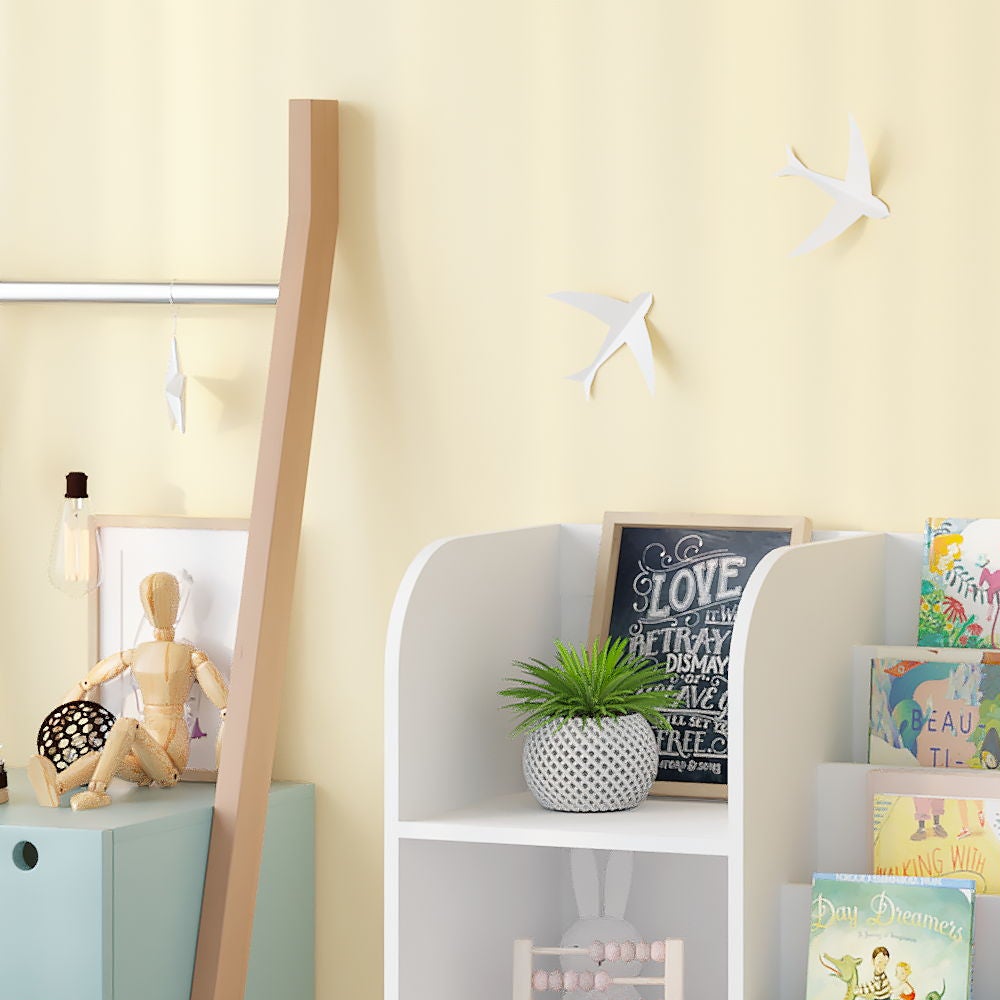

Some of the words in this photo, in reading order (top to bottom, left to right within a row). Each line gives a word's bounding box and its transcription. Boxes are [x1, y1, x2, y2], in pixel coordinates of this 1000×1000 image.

[647, 556, 746, 619] LOVE
[666, 652, 729, 675] DISMAY
[950, 845, 986, 873] WITH
[811, 892, 858, 932] Day
[865, 890, 963, 942] Dreamers
